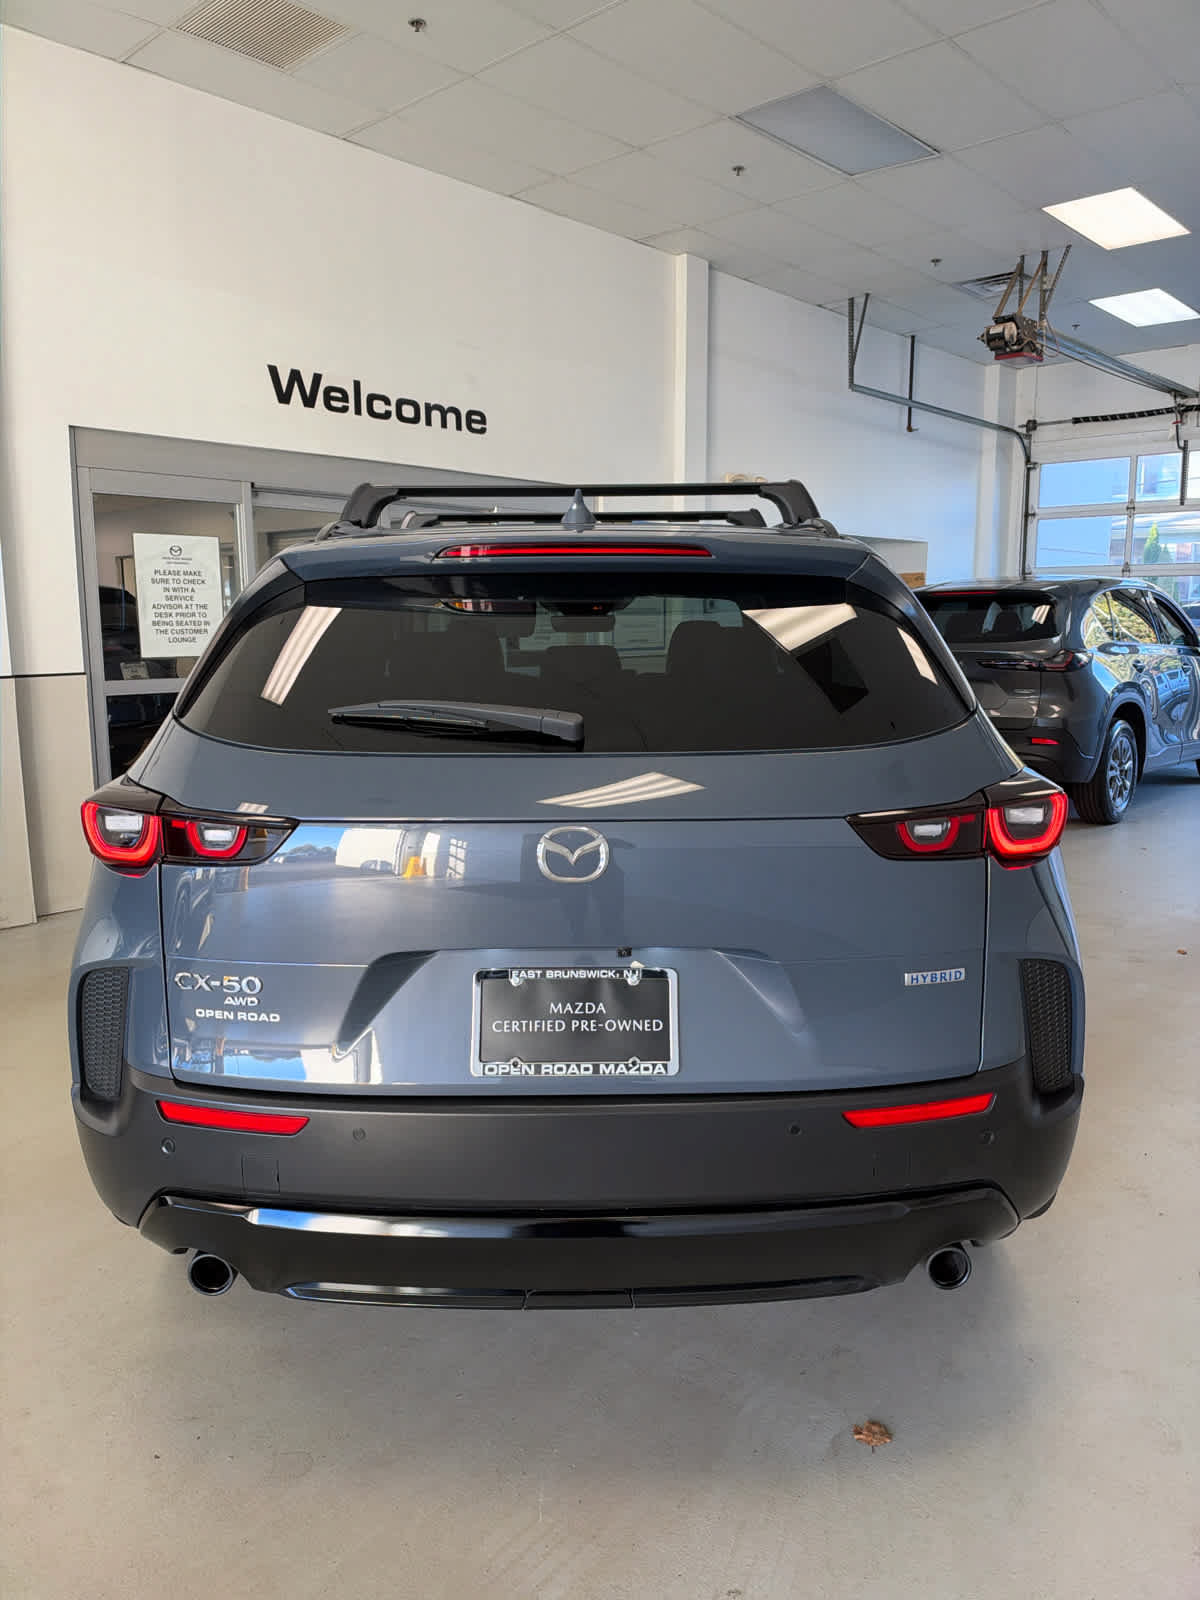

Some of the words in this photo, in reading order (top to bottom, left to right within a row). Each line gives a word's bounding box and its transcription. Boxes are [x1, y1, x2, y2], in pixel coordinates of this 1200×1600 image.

[267, 364, 487, 434] Welcome
[511, 970, 542, 979] EAST
[546, 970, 620, 978] BRUNSWICK,
[911, 970, 962, 984] HYBRID
[174, 971, 262, 994] CX-50
[224, 996, 259, 1006] AWD
[549, 1002, 606, 1014] MAZDA
[195, 1008, 234, 1020] OPEN
[237, 1011, 280, 1022] ROAD
[492, 1020, 566, 1032] CERTIFIED
[571, 1019, 664, 1032] PRE-OWNED
[484, 1063, 535, 1075] OPEN
[540, 1063, 594, 1075] ROAD
[599, 1063, 666, 1075] MAZDA
